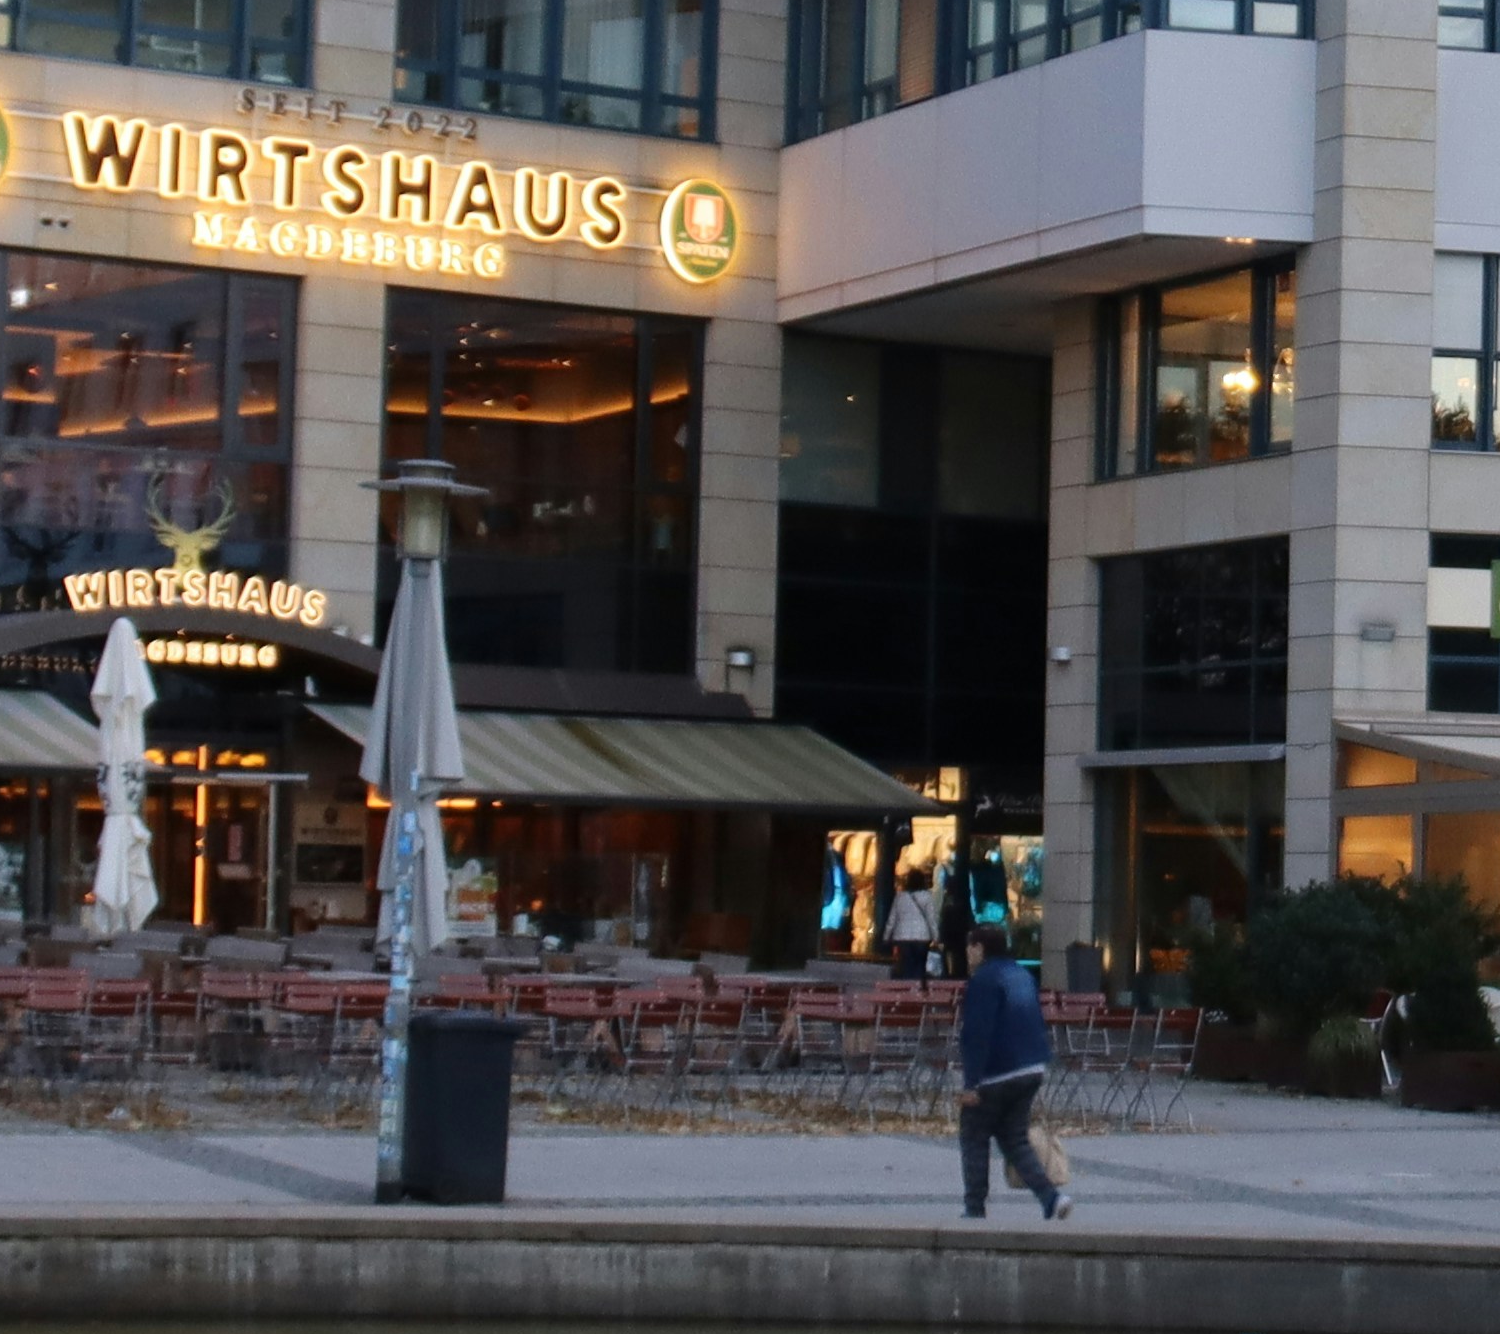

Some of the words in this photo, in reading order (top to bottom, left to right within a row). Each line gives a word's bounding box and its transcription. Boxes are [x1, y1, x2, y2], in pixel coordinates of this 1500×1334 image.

[238, 87, 347, 128] SEIT
[372, 106, 479, 142] 2022
[63, 110, 627, 250] WIRTSHAUS
[192, 210, 507, 279] MAGDEBURG
[675, 241, 731, 259] SPATEN
[63, 566, 328, 627] WIRTSHAUS
